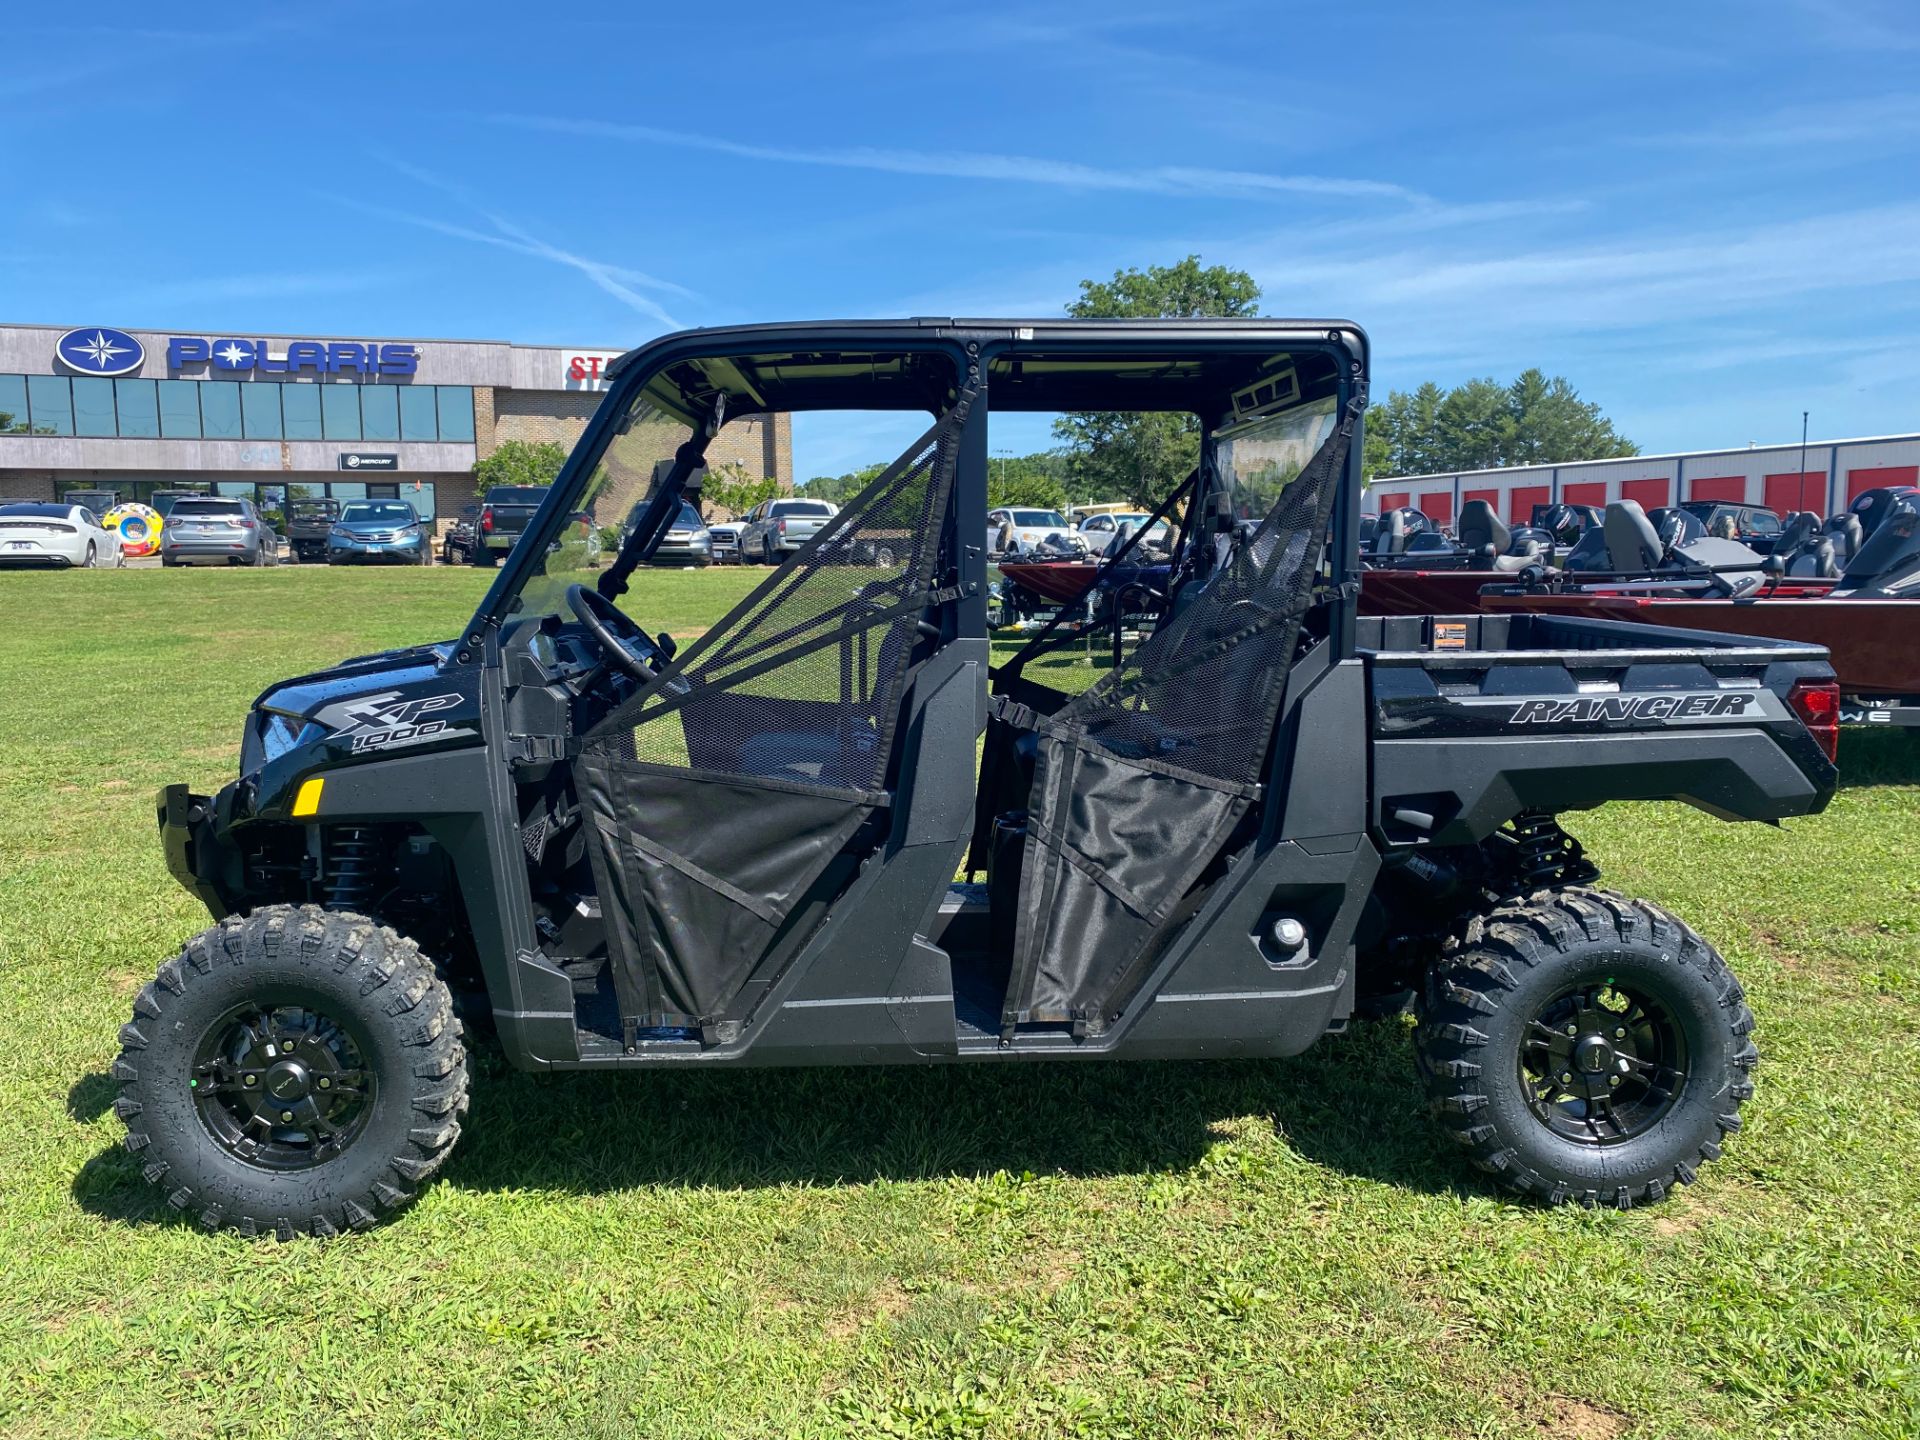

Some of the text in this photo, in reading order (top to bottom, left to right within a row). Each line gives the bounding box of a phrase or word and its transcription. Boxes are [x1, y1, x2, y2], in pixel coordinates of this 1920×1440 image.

[169, 337, 418, 375] POLARIS
[571, 356, 616, 381] ST
[325, 692, 465, 740] XP
[1508, 693, 1756, 724] RANGER
[351, 720, 447, 750] 1000
